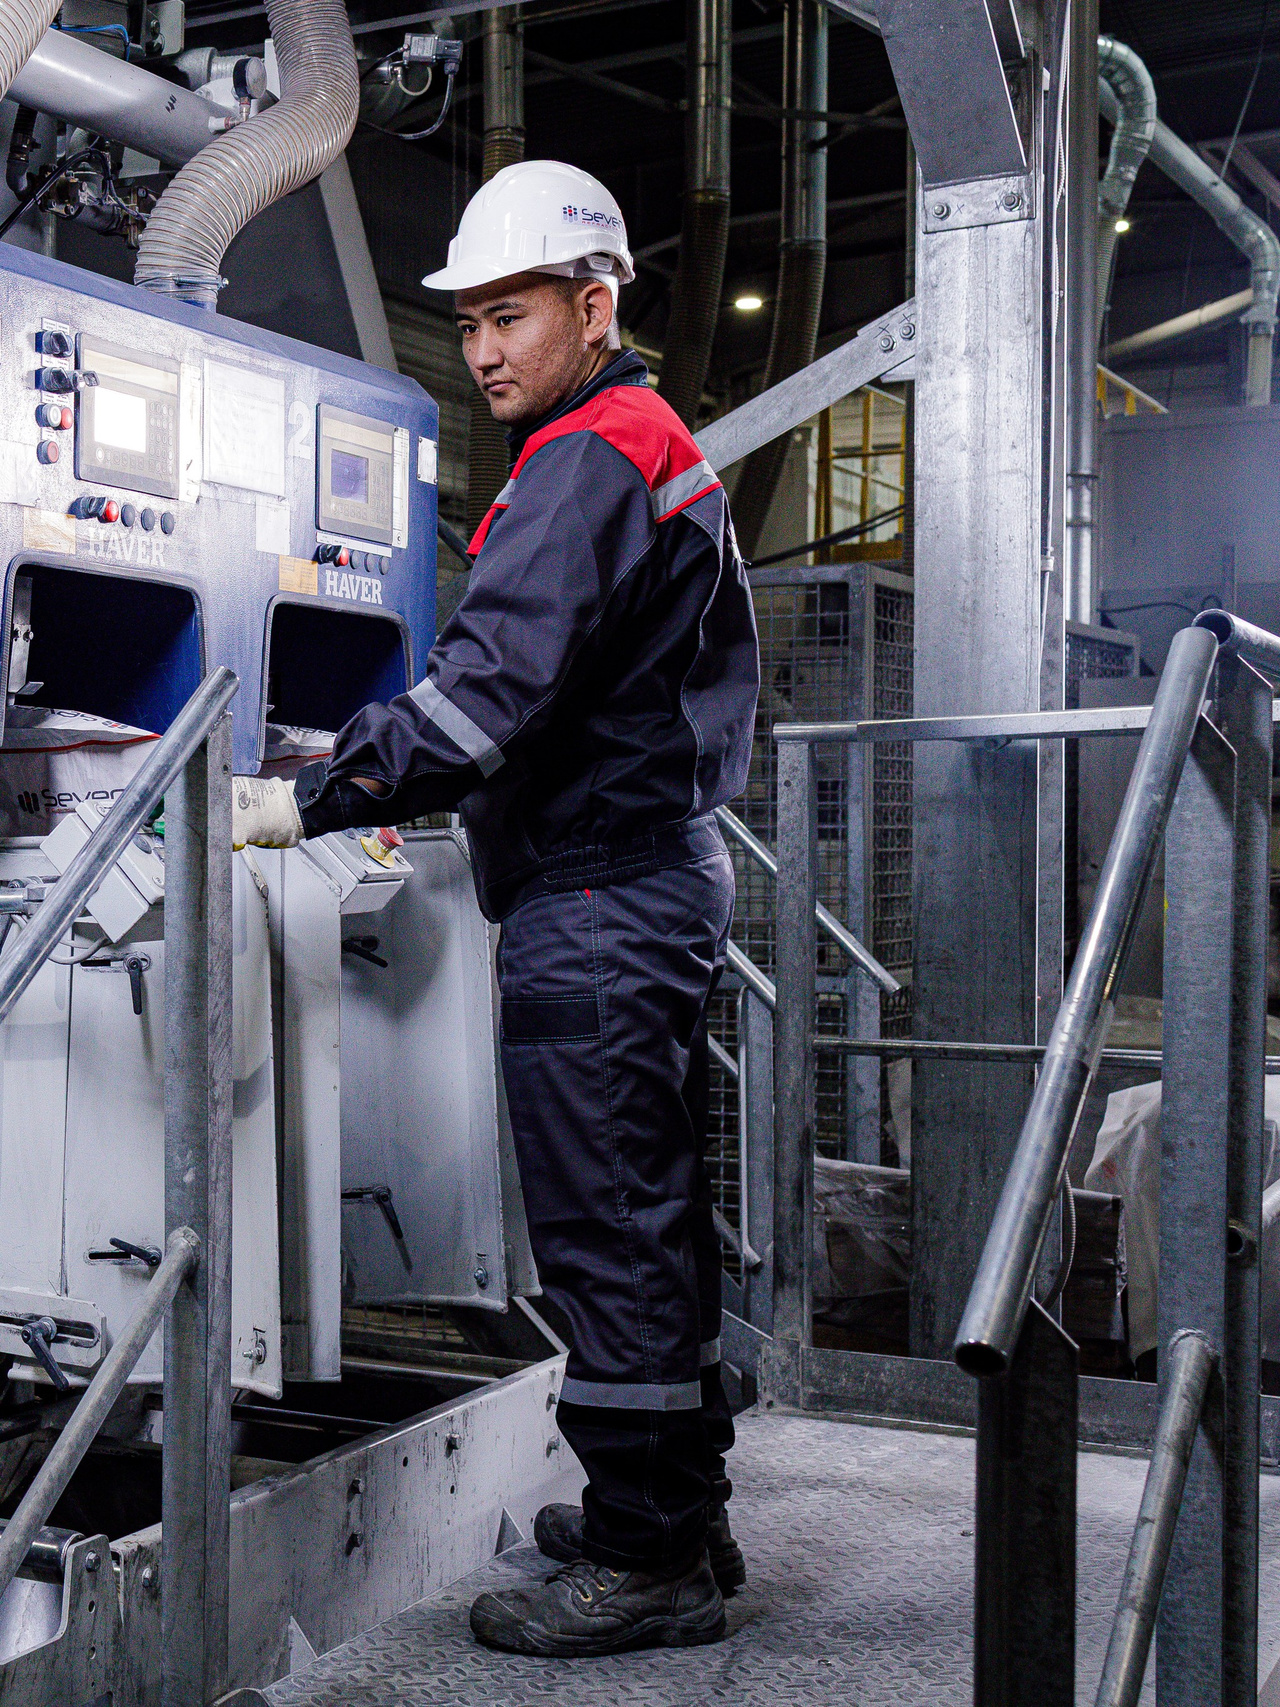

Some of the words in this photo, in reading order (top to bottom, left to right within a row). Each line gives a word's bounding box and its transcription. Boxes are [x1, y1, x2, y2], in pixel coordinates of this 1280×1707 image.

[288, 401, 312, 459] 2
[88, 527, 166, 566] HAVER
[325, 569, 382, 605] HAVER
